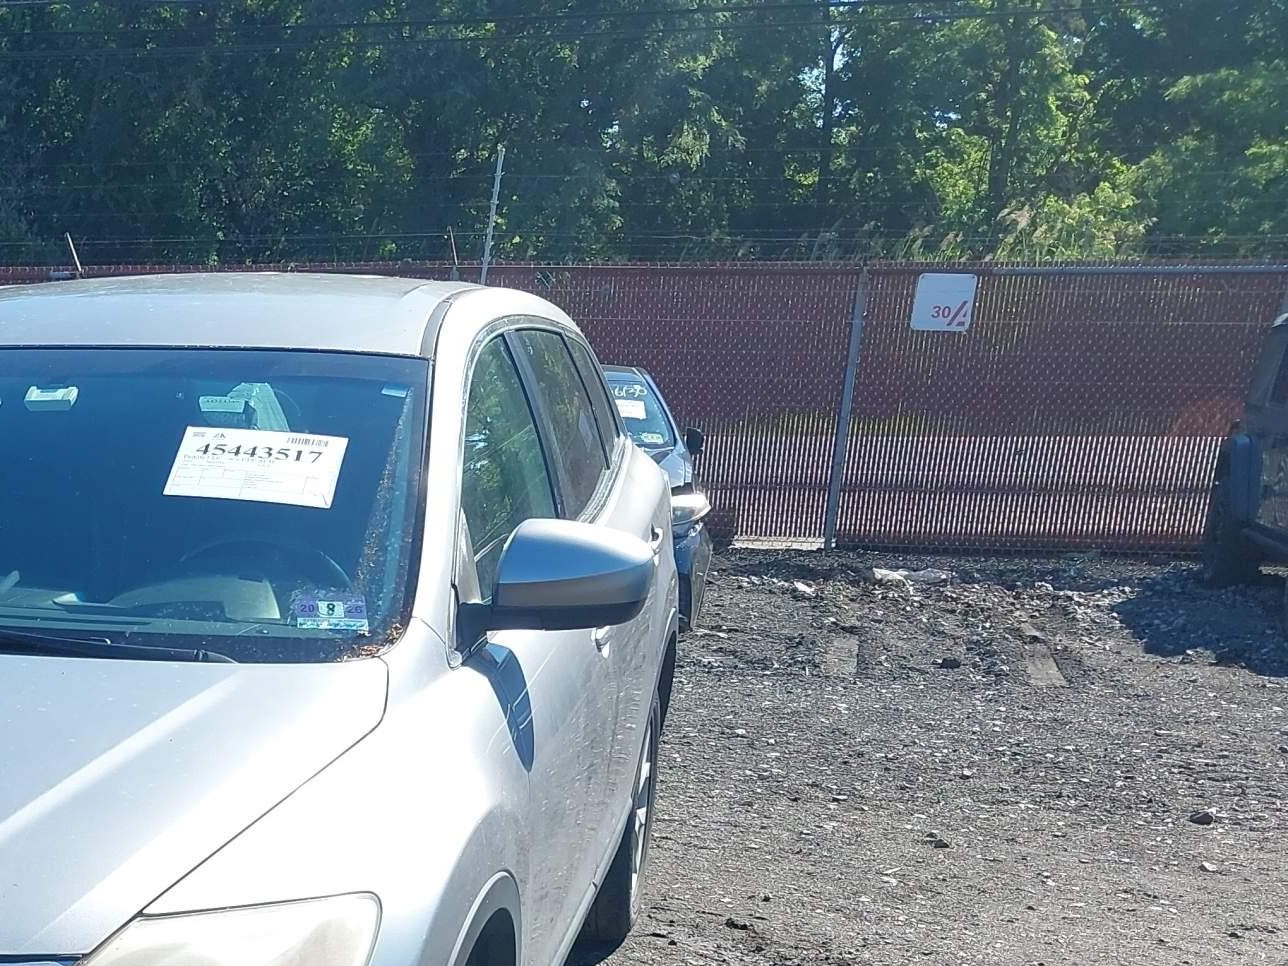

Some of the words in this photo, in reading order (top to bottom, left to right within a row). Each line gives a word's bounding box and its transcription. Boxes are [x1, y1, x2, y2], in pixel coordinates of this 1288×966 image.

[196, 443, 324, 464] 45443517
[300, 604, 315, 613] 20
[326, 602, 336, 616] 8
